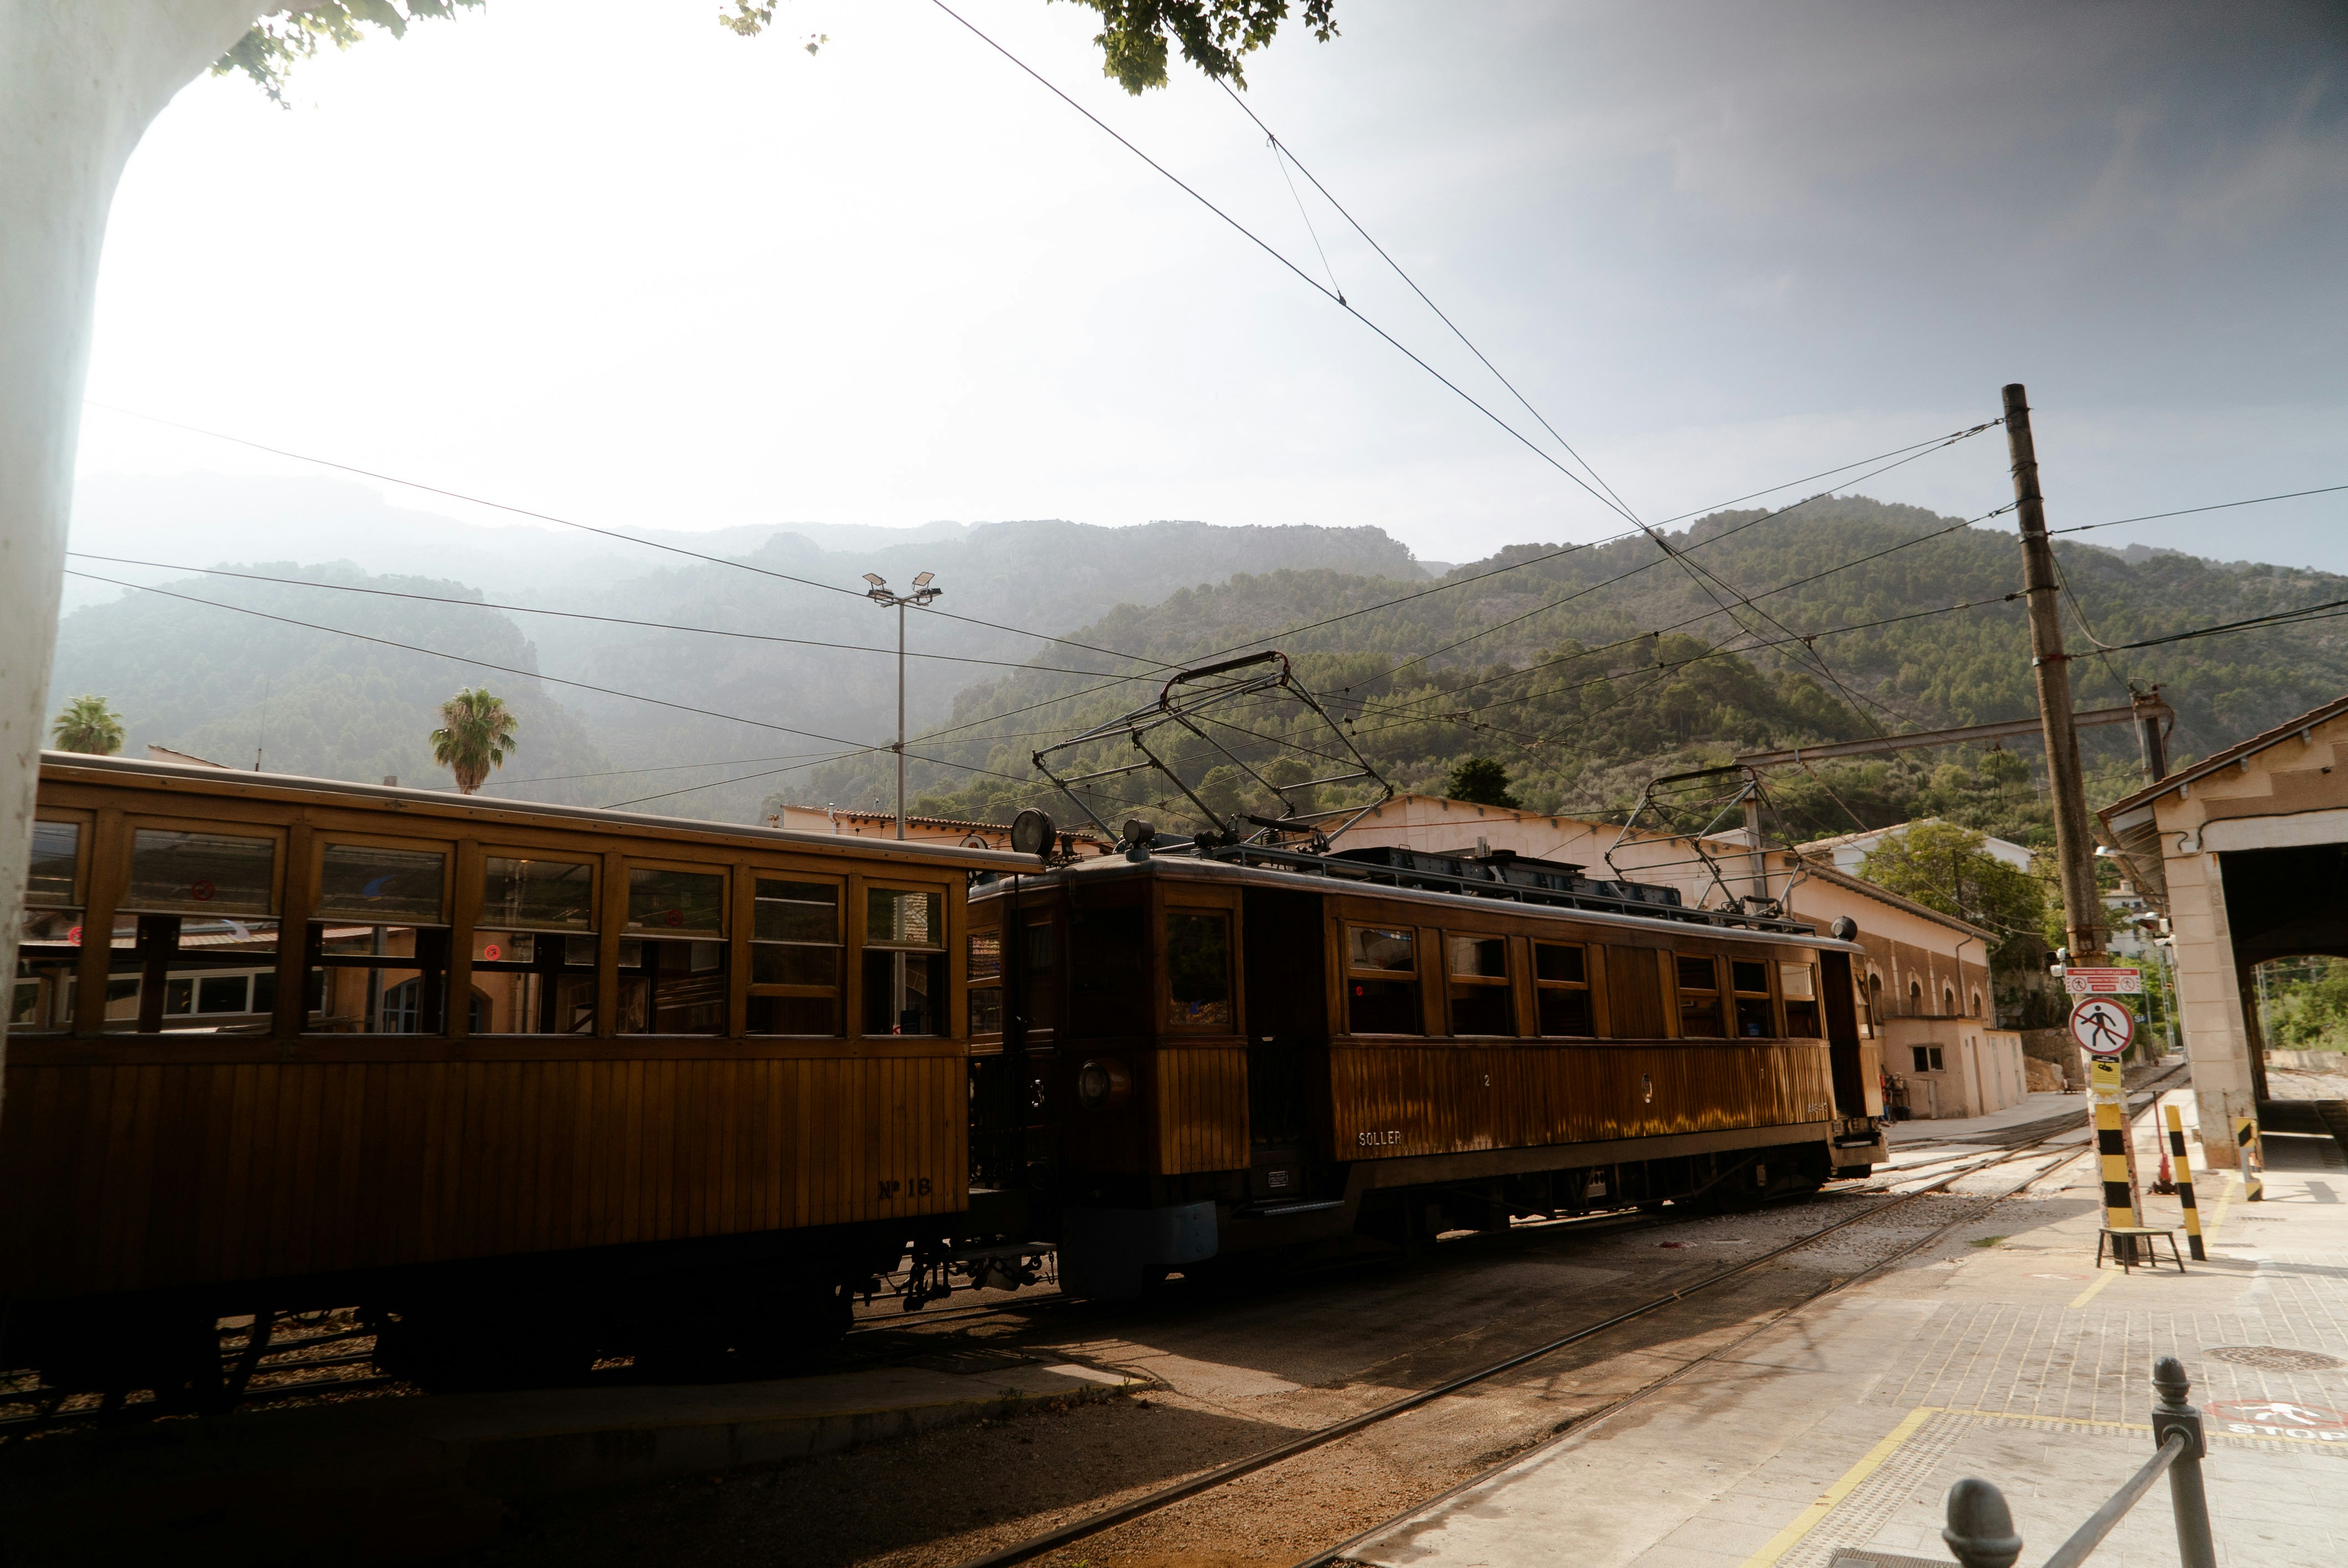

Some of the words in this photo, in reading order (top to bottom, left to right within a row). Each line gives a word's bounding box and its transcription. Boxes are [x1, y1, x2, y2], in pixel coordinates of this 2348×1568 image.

[1484, 1075, 1490, 1086] 2
[1358, 1131, 1402, 1146] SOLLER
[909, 1178, 931, 1197] 18
[2228, 1423, 2347, 1441] STOP
